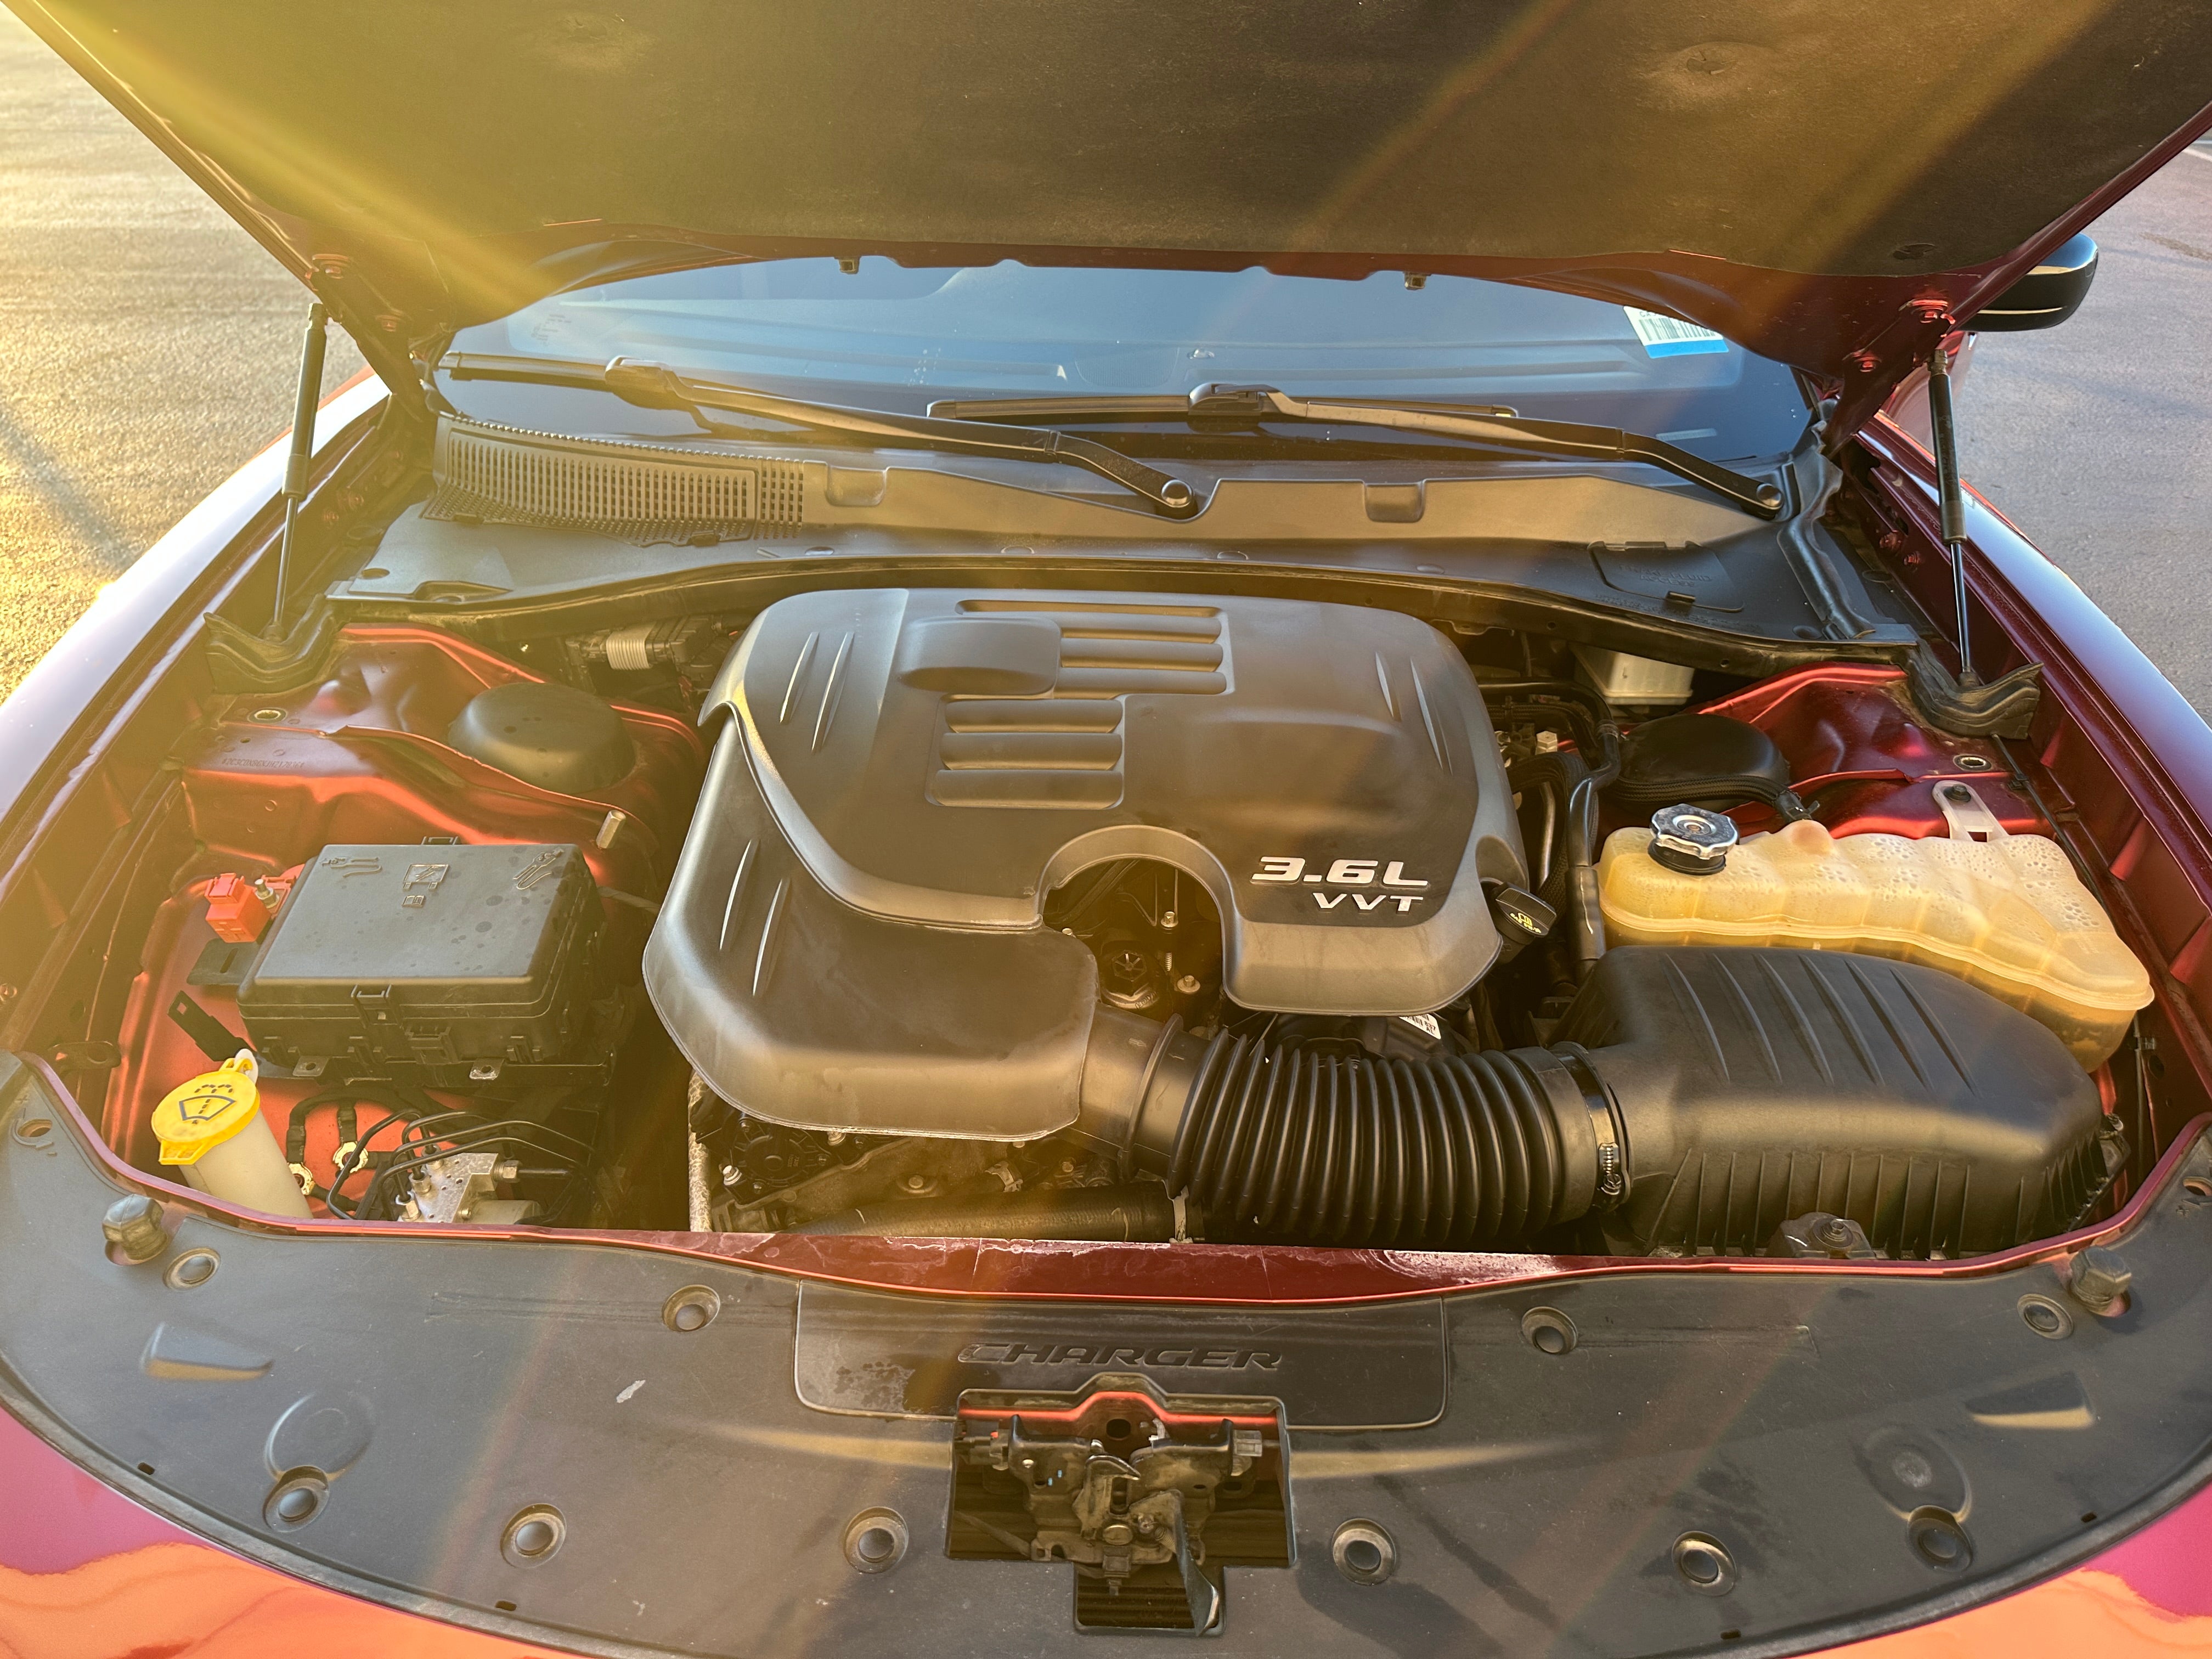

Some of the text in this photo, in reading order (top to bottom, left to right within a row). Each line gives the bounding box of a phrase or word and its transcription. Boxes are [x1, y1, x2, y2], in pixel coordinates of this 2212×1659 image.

[1640, 574, 1696, 588] ACCESS
[1671, 572, 1712, 582] FLUID
[1251, 856, 1429, 886] 3.6L
[1312, 892, 1424, 912] VVT
[957, 1342, 1283, 1371] CHARGER
